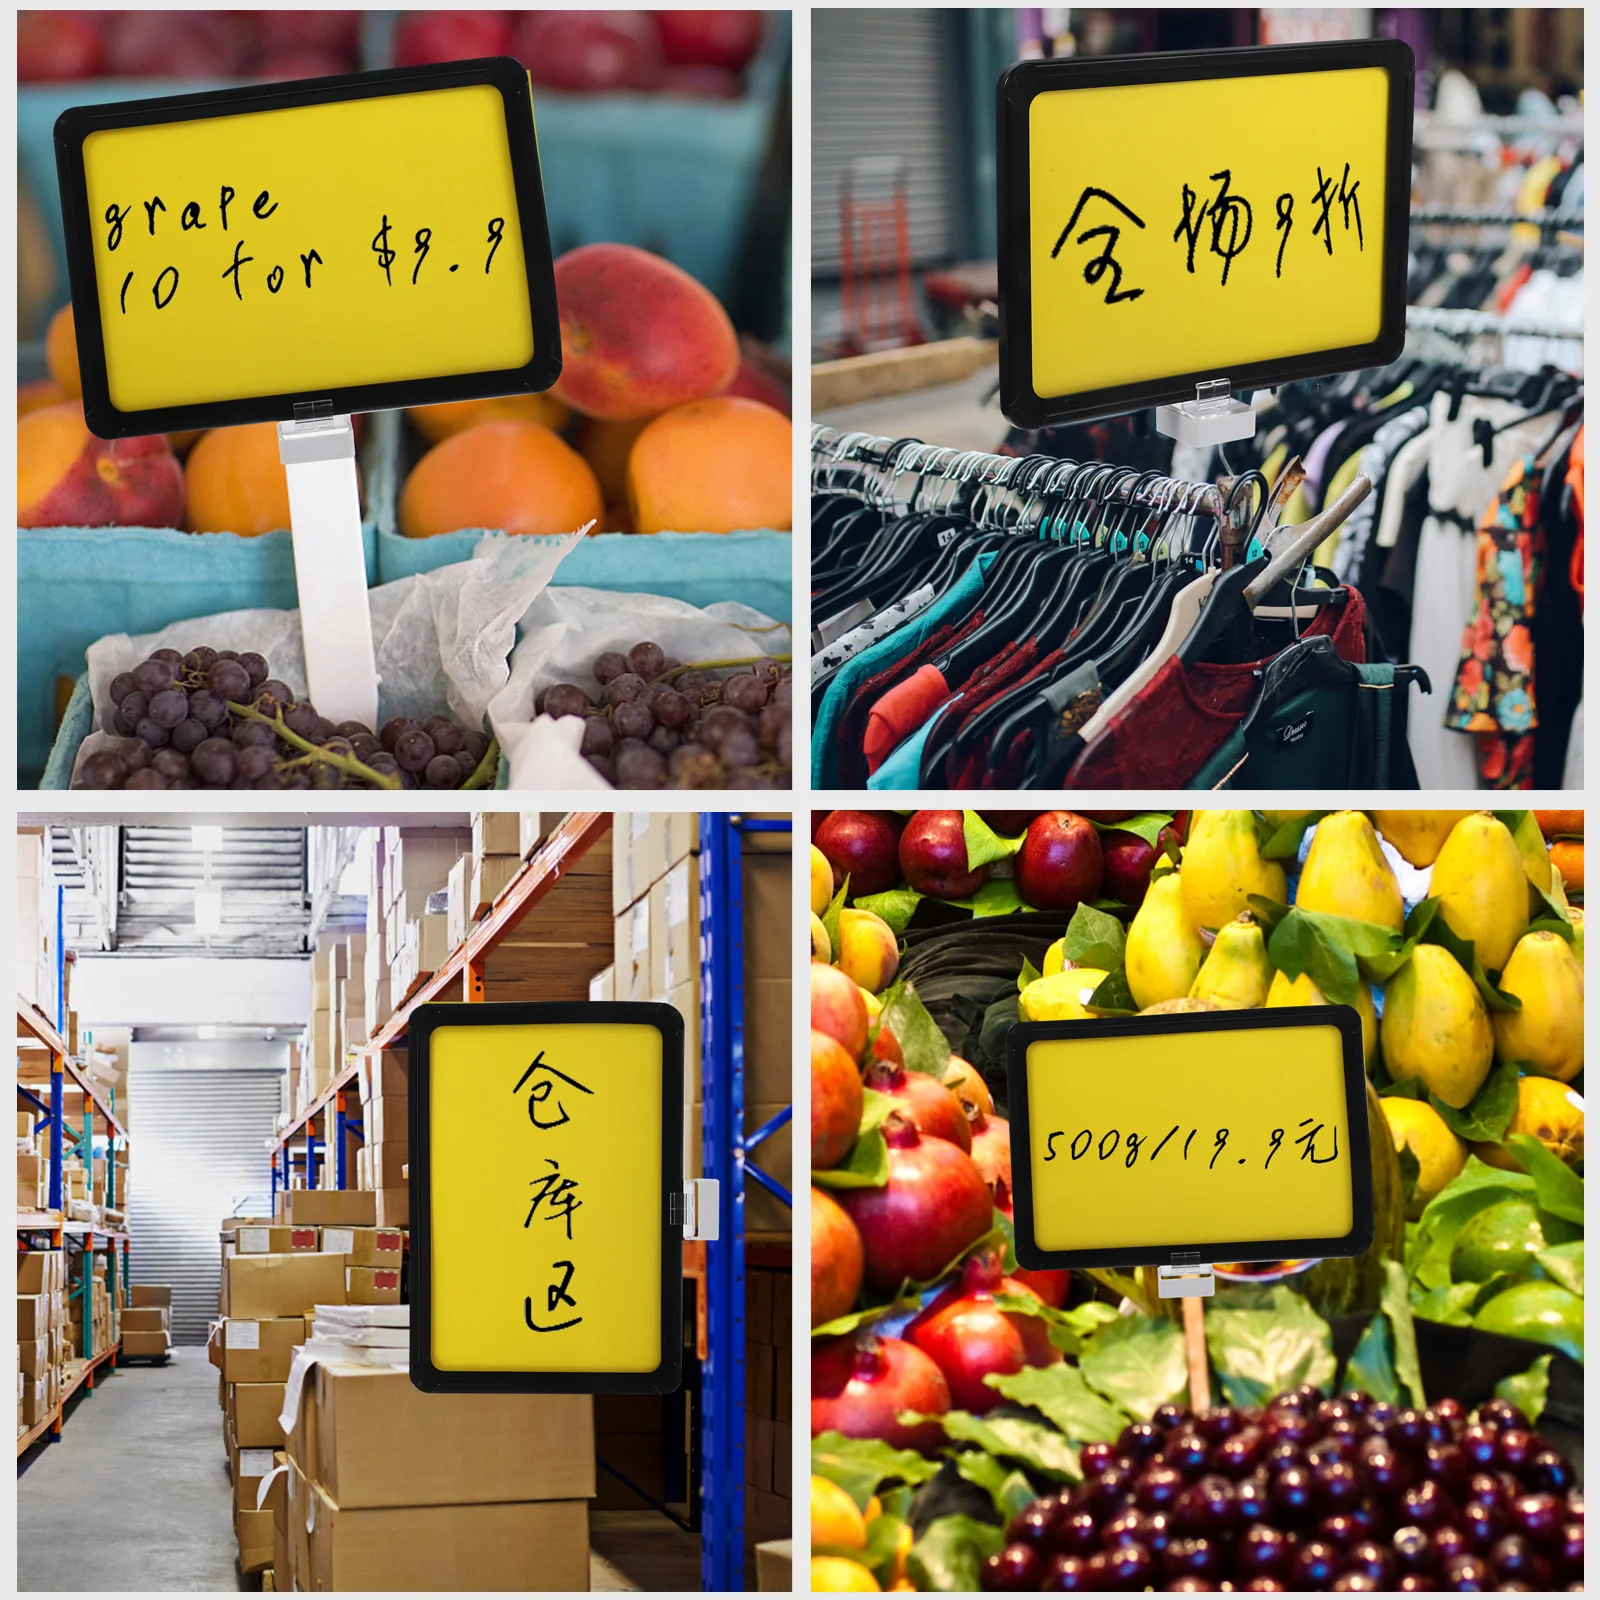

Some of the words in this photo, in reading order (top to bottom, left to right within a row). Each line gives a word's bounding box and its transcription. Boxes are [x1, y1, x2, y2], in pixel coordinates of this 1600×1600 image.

[104, 186, 279, 251] grape
[121, 266, 180, 314] 10
[222, 240, 323, 300] for
[372, 215, 505, 286] $9.9
[1044, 1119, 1338, 1169] 500g/19.9元
